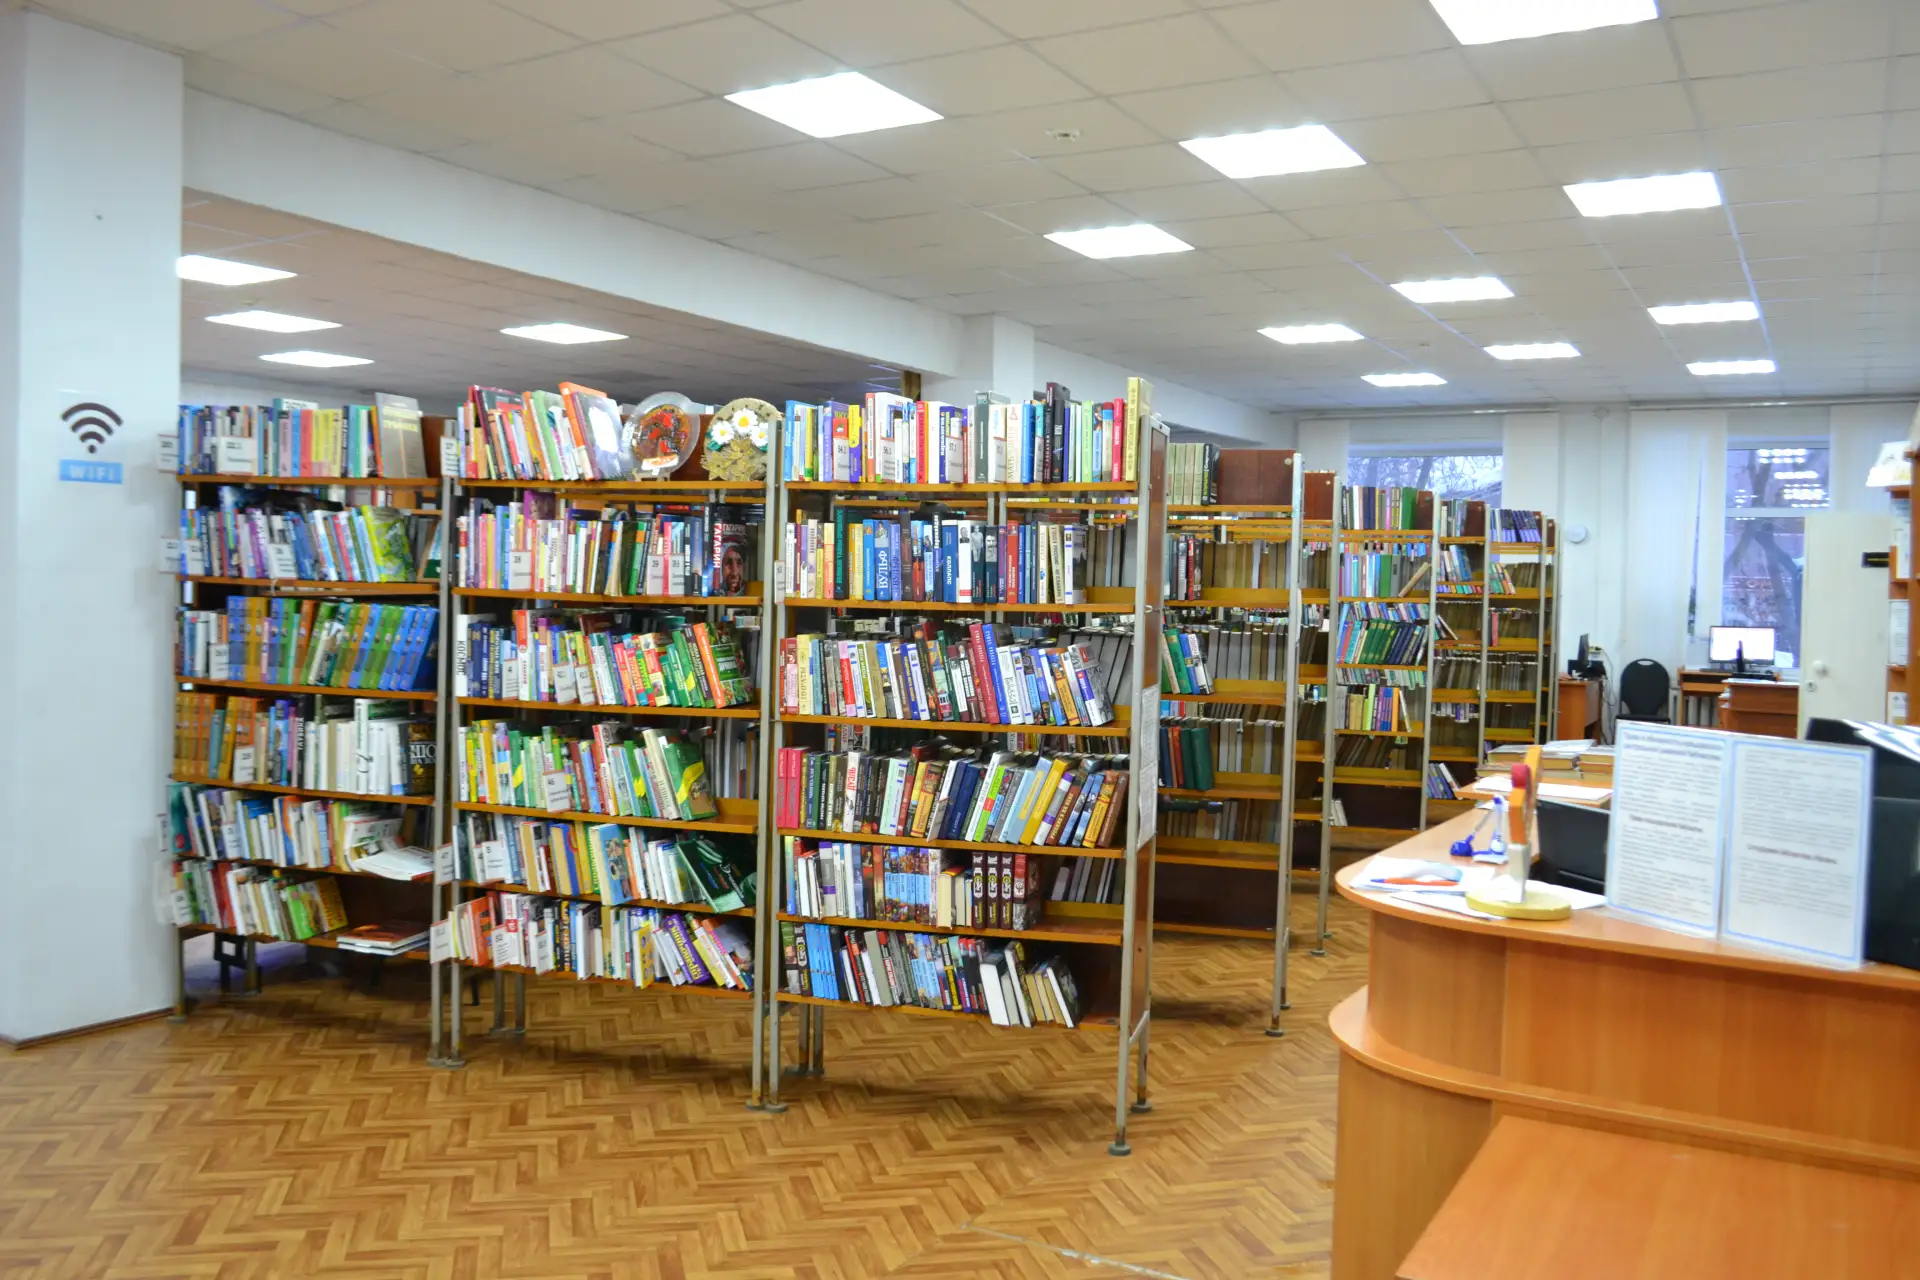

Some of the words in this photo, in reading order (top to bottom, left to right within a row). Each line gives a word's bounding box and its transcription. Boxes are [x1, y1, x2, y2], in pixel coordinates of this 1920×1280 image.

[713, 522, 722, 568] ГАГАРИН
[878, 550, 888, 588] ВУЛЬФ
[456, 640, 466, 676] КОСМОС
[800, 667, 808, 701] ПИРАТЫ
[847, 766, 856, 791] ДУЭЛЬ
